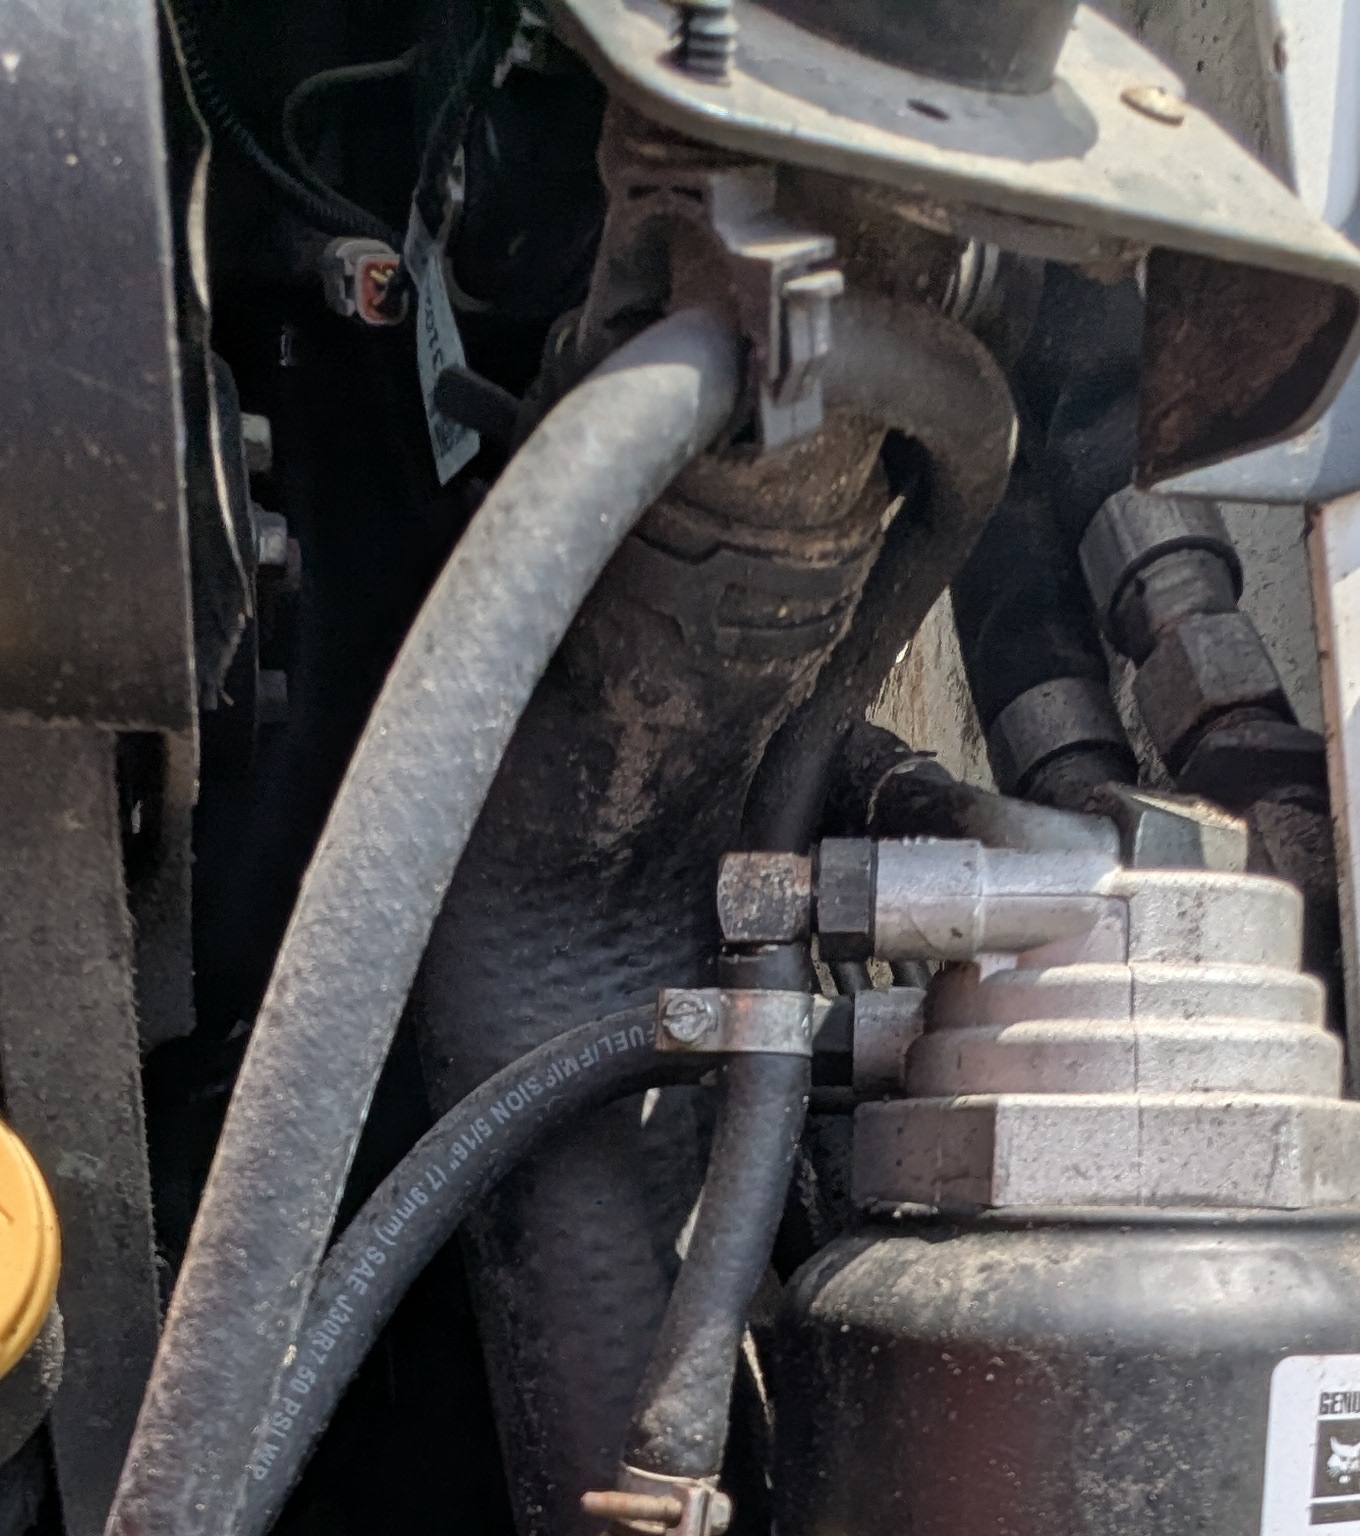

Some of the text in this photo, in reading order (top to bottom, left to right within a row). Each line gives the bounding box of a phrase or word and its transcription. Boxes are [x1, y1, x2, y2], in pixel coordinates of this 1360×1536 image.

[449, 1117, 493, 1171] 5/16"
[374, 1164, 449, 1247] (7.9mm)
[345, 1246, 386, 1295] SAE
[311, 1294, 354, 1365] J30R7
[290, 1365, 317, 1394] 50
[270, 1397, 302, 1438] PSI
